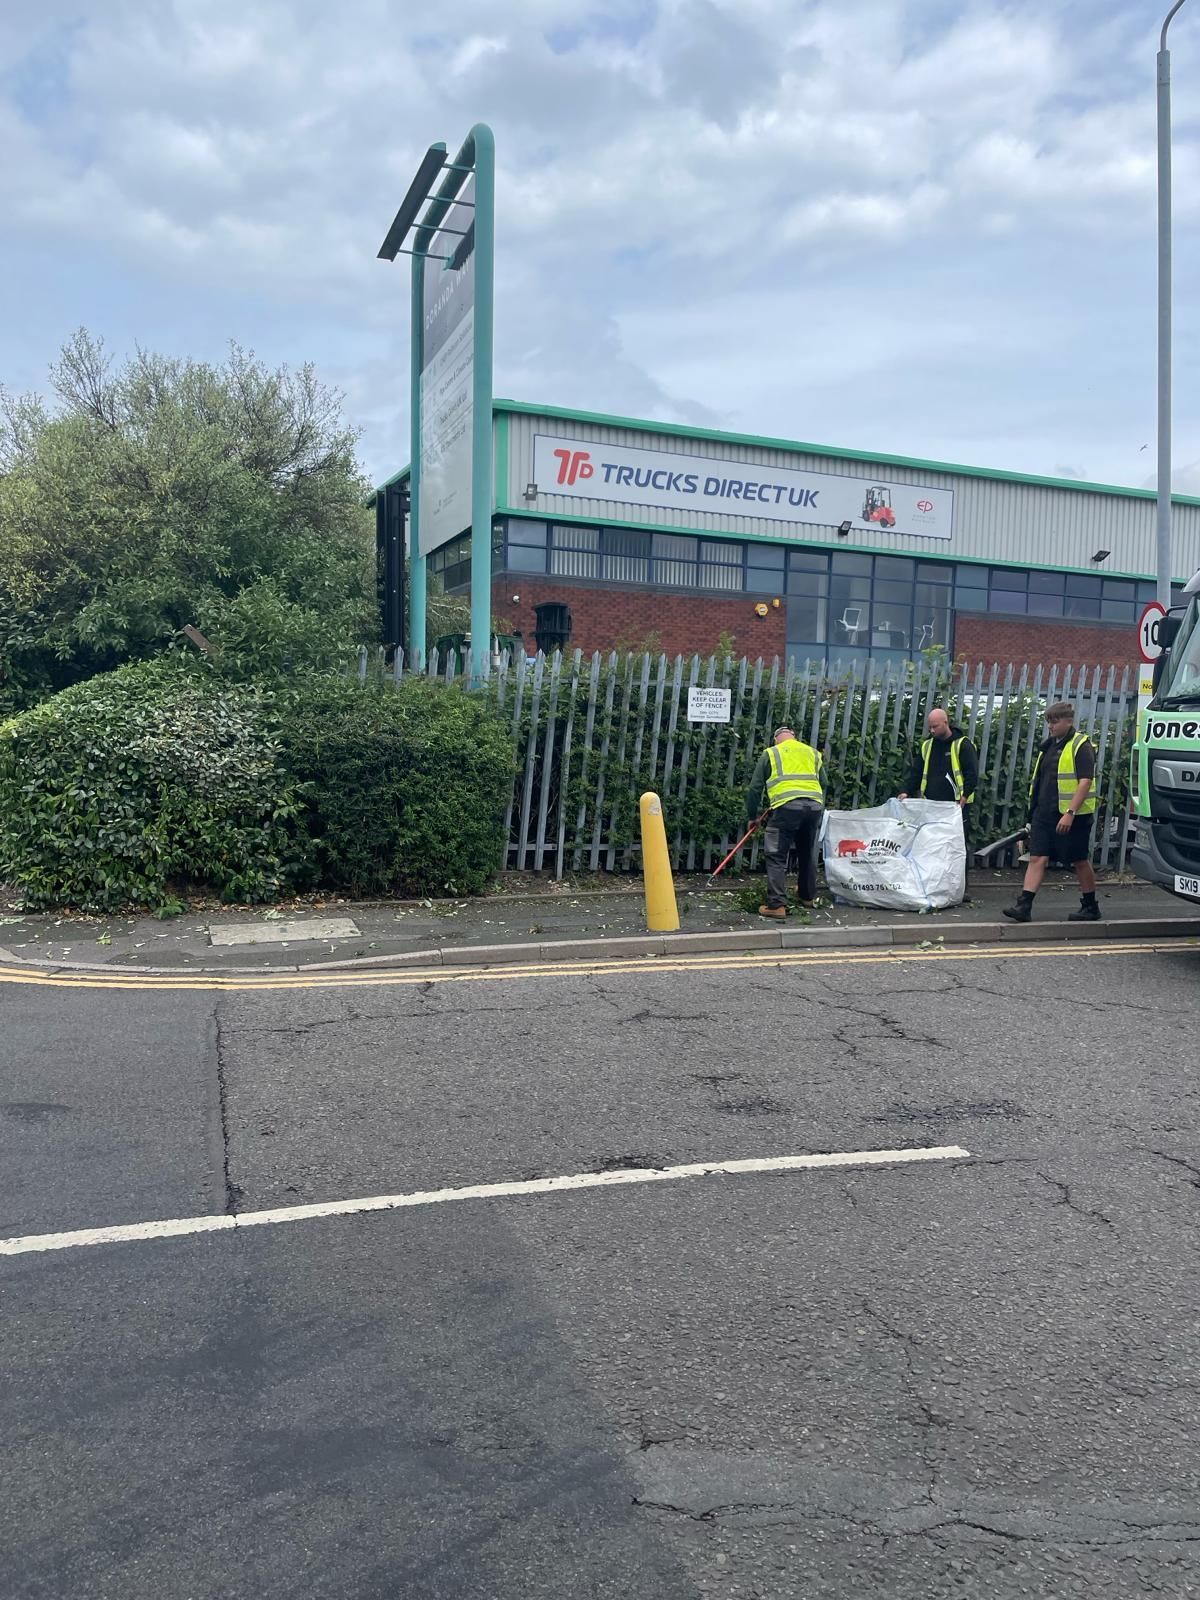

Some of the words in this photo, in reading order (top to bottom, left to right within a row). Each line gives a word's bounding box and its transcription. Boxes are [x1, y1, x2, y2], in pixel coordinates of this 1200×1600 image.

[601, 463, 699, 493] TRUCKS
[1144, 718, 1200, 743] jone
[853, 883, 874, 891] 01493
[1180, 877, 1198, 893] SK19
